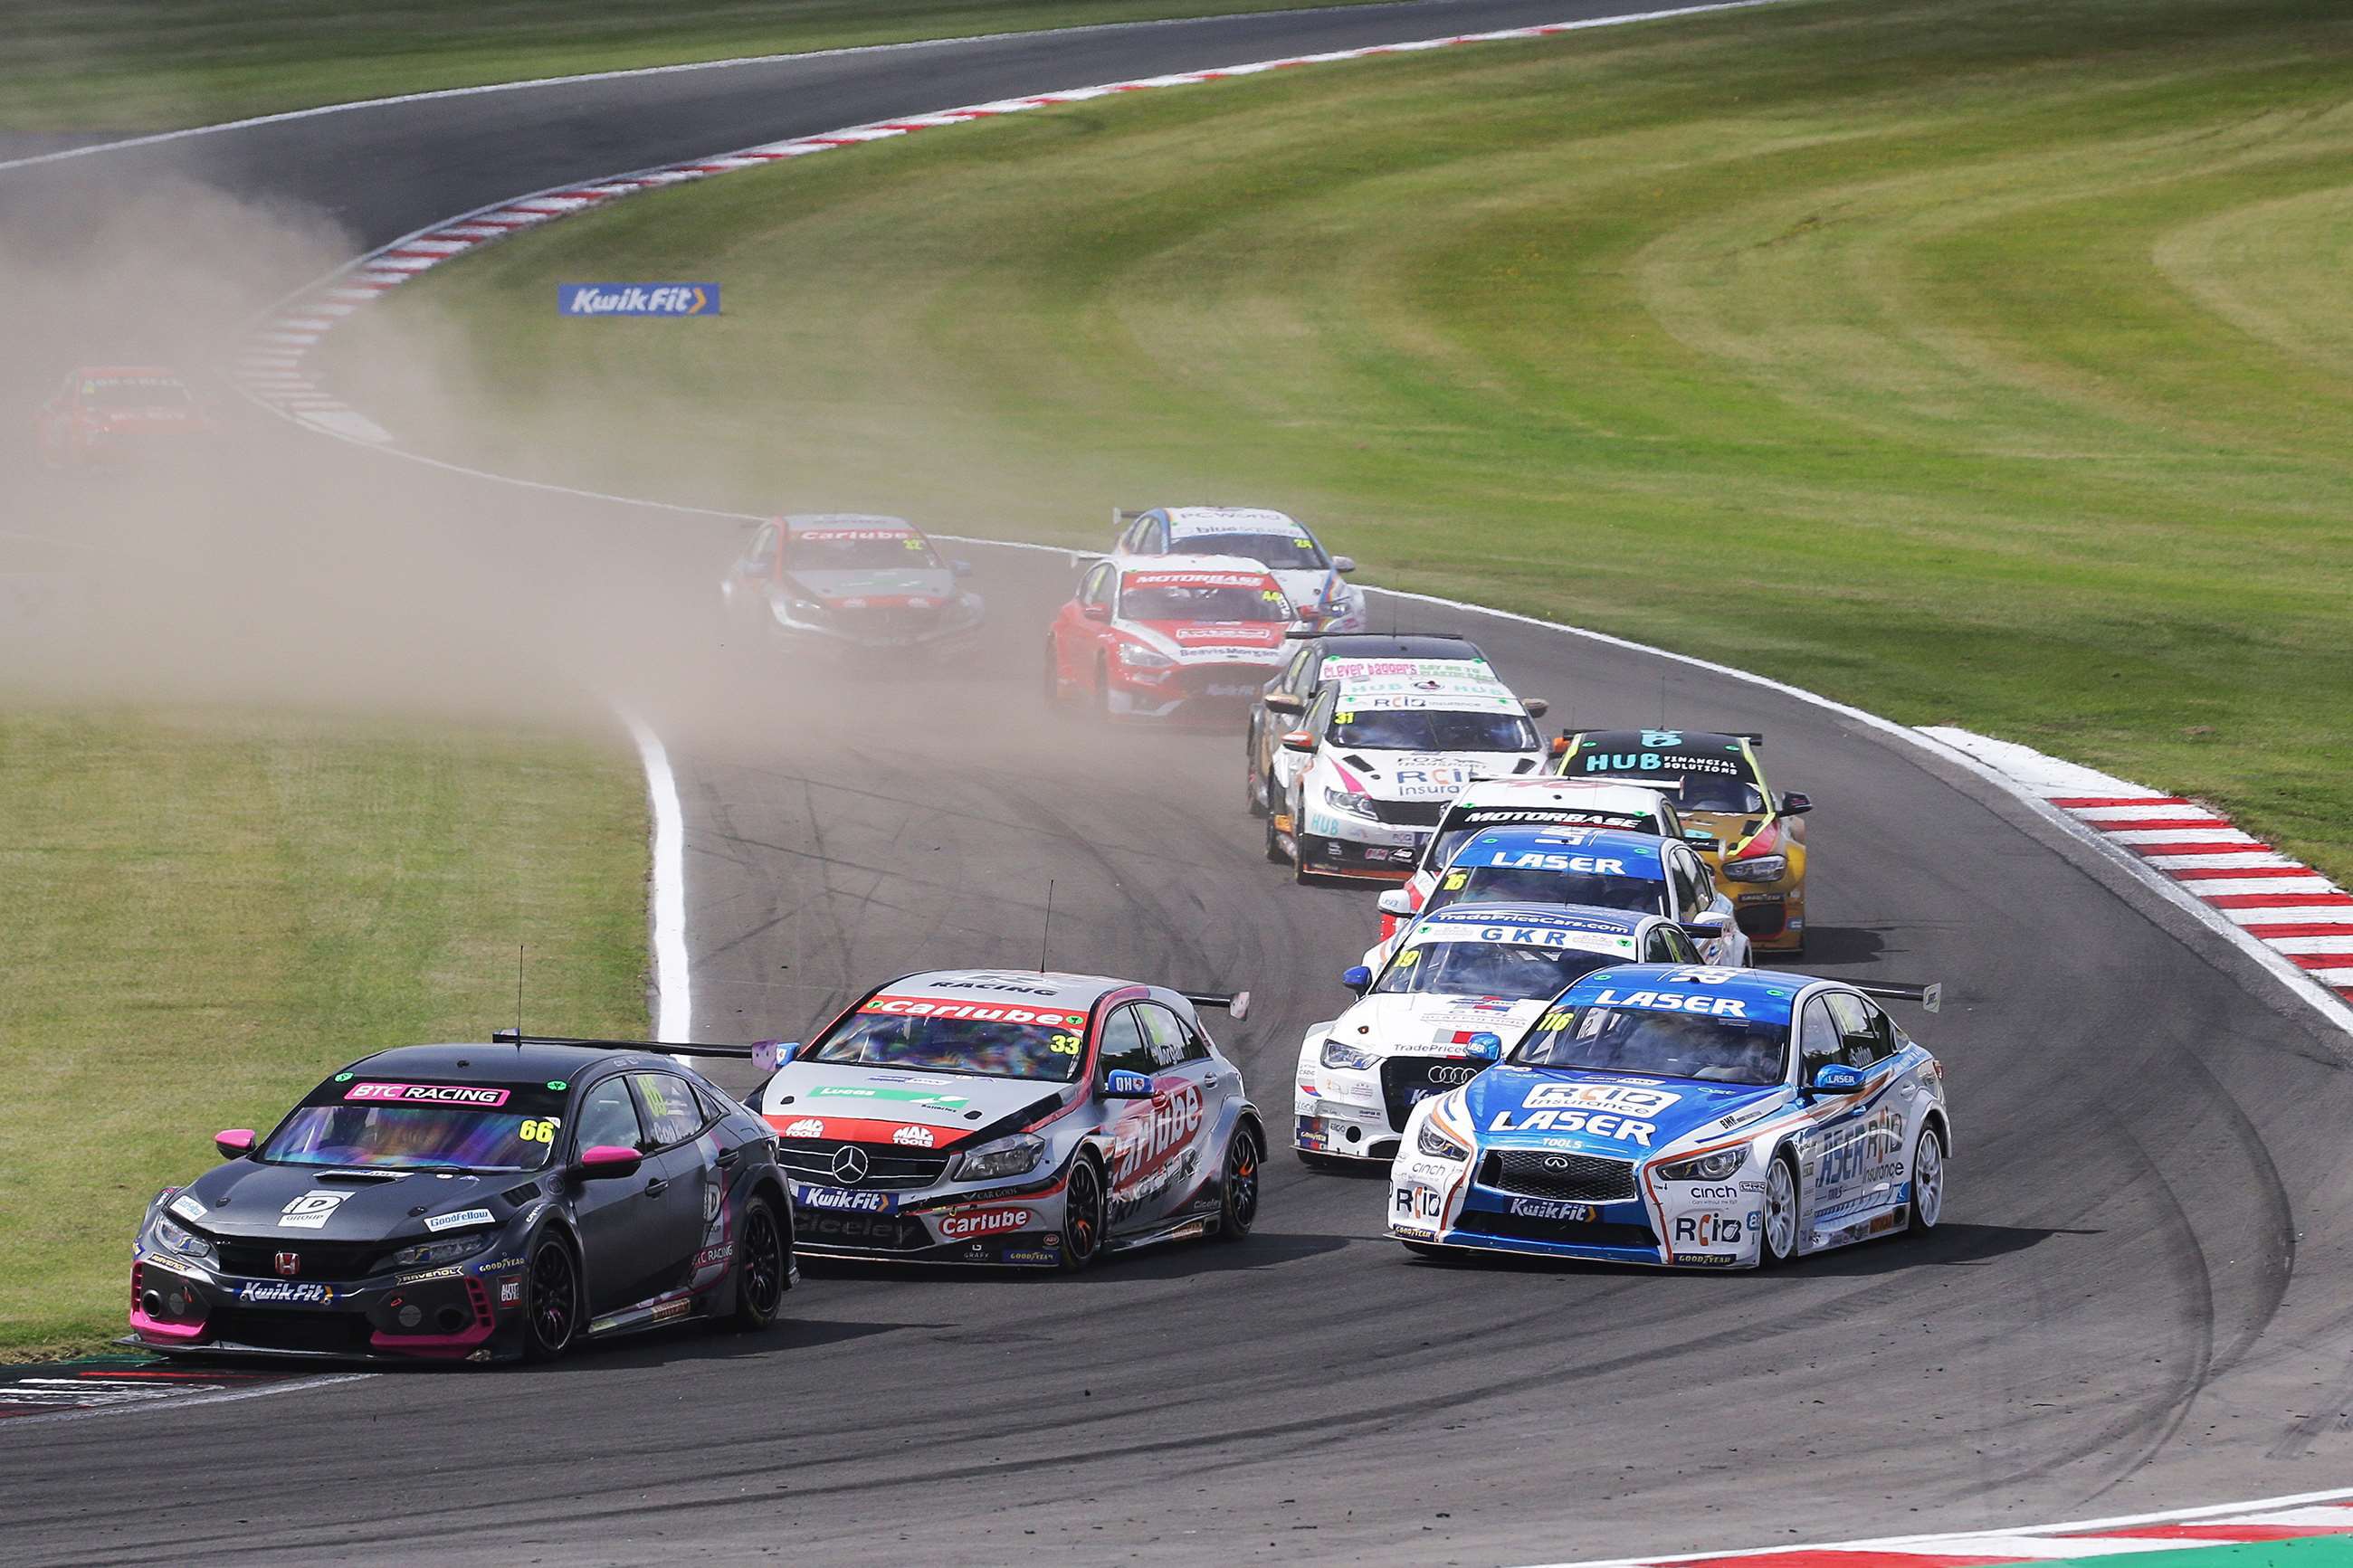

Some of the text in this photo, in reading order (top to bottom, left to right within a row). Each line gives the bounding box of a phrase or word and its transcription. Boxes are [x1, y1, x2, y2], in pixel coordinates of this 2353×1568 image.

[1137, 574, 1265, 586] MOTORBASE
[1334, 712, 1354, 724] 31
[1586, 753, 1662, 771] HUB
[1663, 755, 1737, 768] FINANCIAL
[1663, 763, 1738, 775] SOLUTIONS
[1399, 785, 1463, 796] Insura
[1312, 814, 1338, 836] HUB
[1464, 812, 1643, 829] MOTORBASE
[1491, 851, 1627, 875] LASER
[1443, 873, 1467, 890] 16
[1395, 950, 1420, 968] 19
[929, 981, 1059, 996] RACING
[1594, 989, 1747, 1018] LASER
[881, 1000, 1064, 1025] Carlube
[1535, 1012, 1575, 1032] 116
[1050, 1034, 1081, 1056] 33
[1826, 1074, 1855, 1084] LASER
[353, 1085, 499, 1102] BTC RACING
[519, 1120, 554, 1143] 66
[787, 1118, 824, 1131] MAC
[1488, 1110, 1657, 1148] LASER
[785, 1129, 822, 1138] TOOLS
[893, 1126, 934, 1139] MAC
[892, 1136, 934, 1147] TOOLS
[1541, 1137, 1584, 1149] TOOLS
[1412, 1162, 1445, 1176] cinch
[1691, 1185, 1738, 1199] cinch
[430, 1210, 489, 1227] GoodFellow
[942, 1211, 1028, 1235] Carlube
[708, 1244, 734, 1261] RACING
[1679, 1254, 1731, 1264] GOODYEAR
[479, 1257, 526, 1272] GOODYEAR
[402, 1267, 458, 1282] RAVENOL
